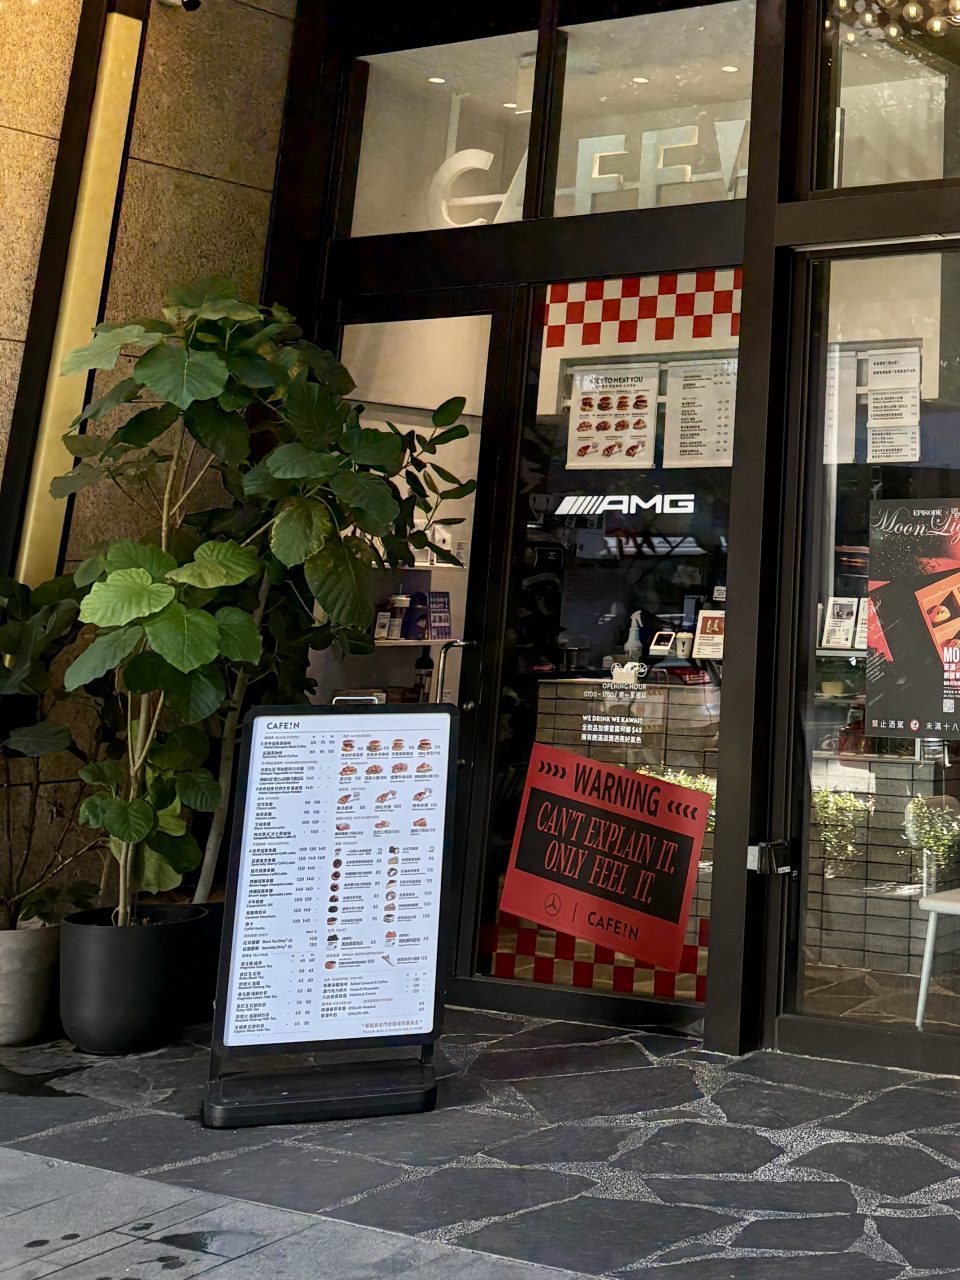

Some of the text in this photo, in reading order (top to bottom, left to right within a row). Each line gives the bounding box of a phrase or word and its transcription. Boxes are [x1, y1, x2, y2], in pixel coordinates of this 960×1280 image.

[613, 376, 629, 384] MEAT
[597, 494, 695, 514] AMG
[869, 507, 925, 536] Moon
[266, 721, 300, 730] CAFE!N
[592, 715, 611, 723] DRINK
[871, 720, 904, 729] 禁止酒駕
[574, 763, 661, 817] WARNING
[536, 801, 679, 875] CAN'T EXPLAIN IT.
[544, 840, 656, 904] ONLY FEEL IT.
[587, 911, 639, 941] CAFE!N
